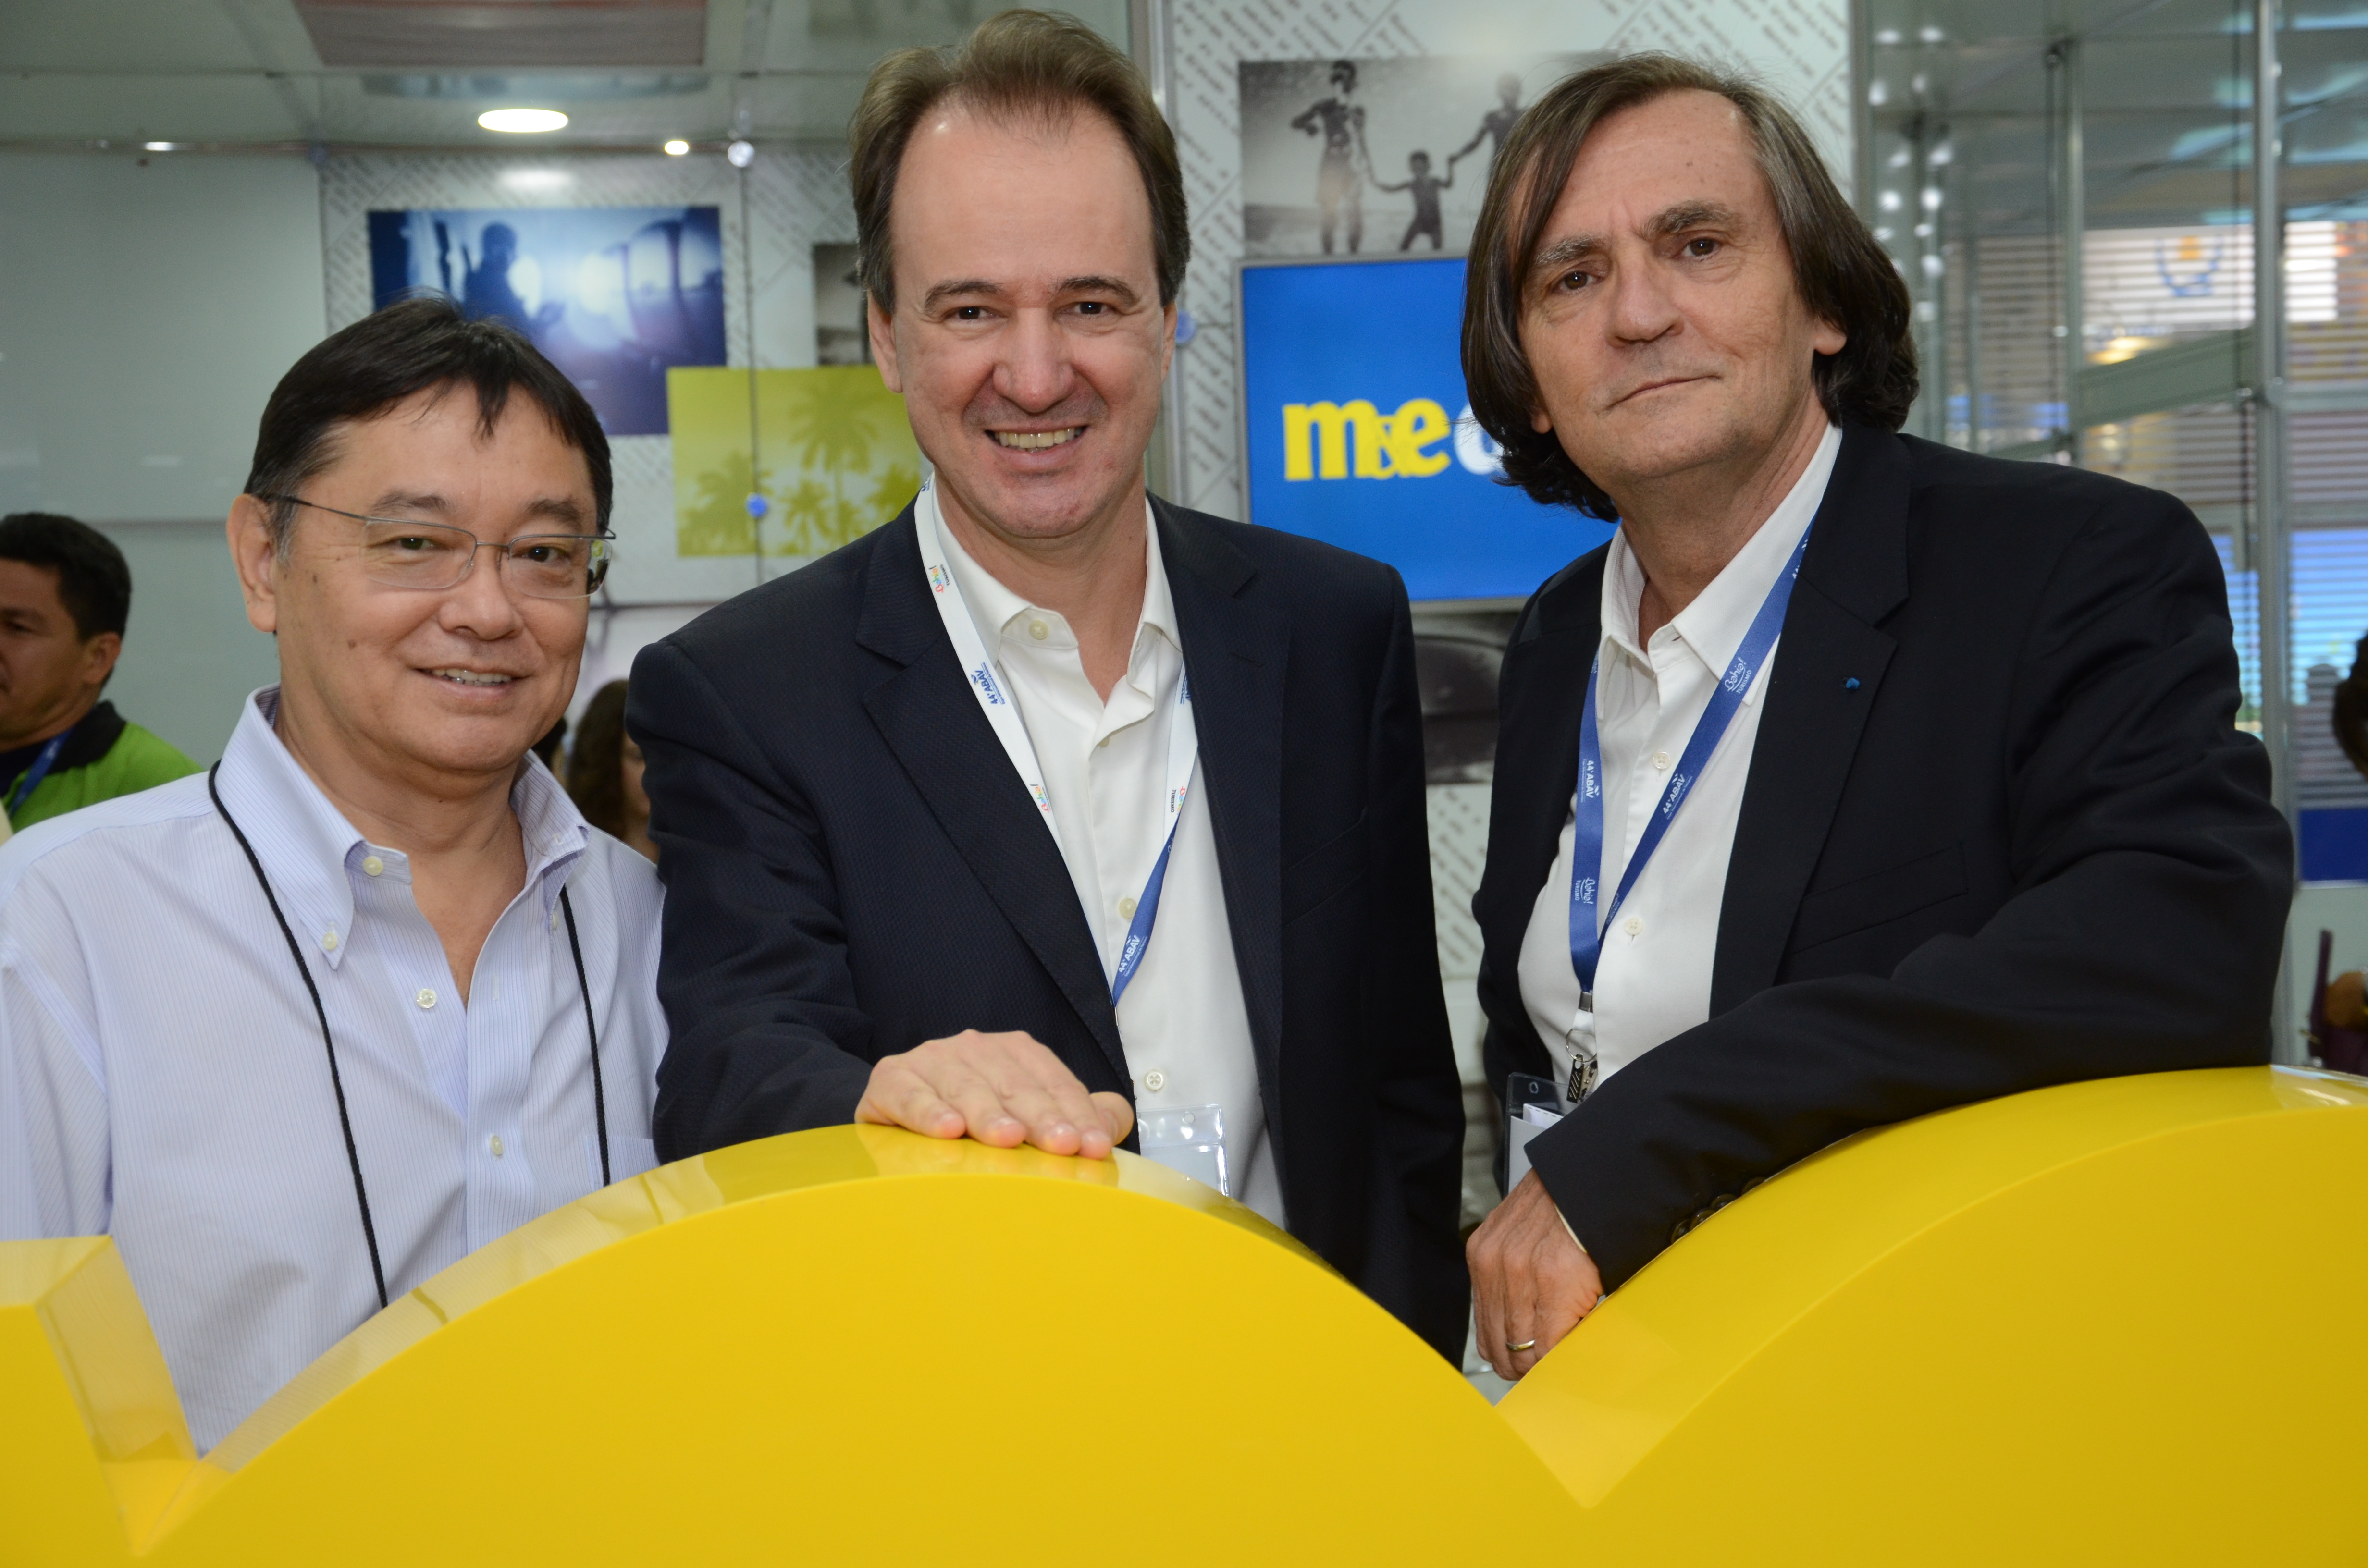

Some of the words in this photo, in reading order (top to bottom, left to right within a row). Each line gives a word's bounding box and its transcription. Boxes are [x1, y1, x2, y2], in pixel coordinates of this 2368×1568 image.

[974, 670, 993, 692] ABAV
[1725, 657, 1746, 692] Bahia!
[1736, 670, 1751, 694] TURISMO
[1586, 773, 1594, 798] ABAV
[1670, 774, 1685, 802] ABAV
[1583, 877, 1596, 904] Bahia!
[1124, 934, 1141, 961] ABAV
